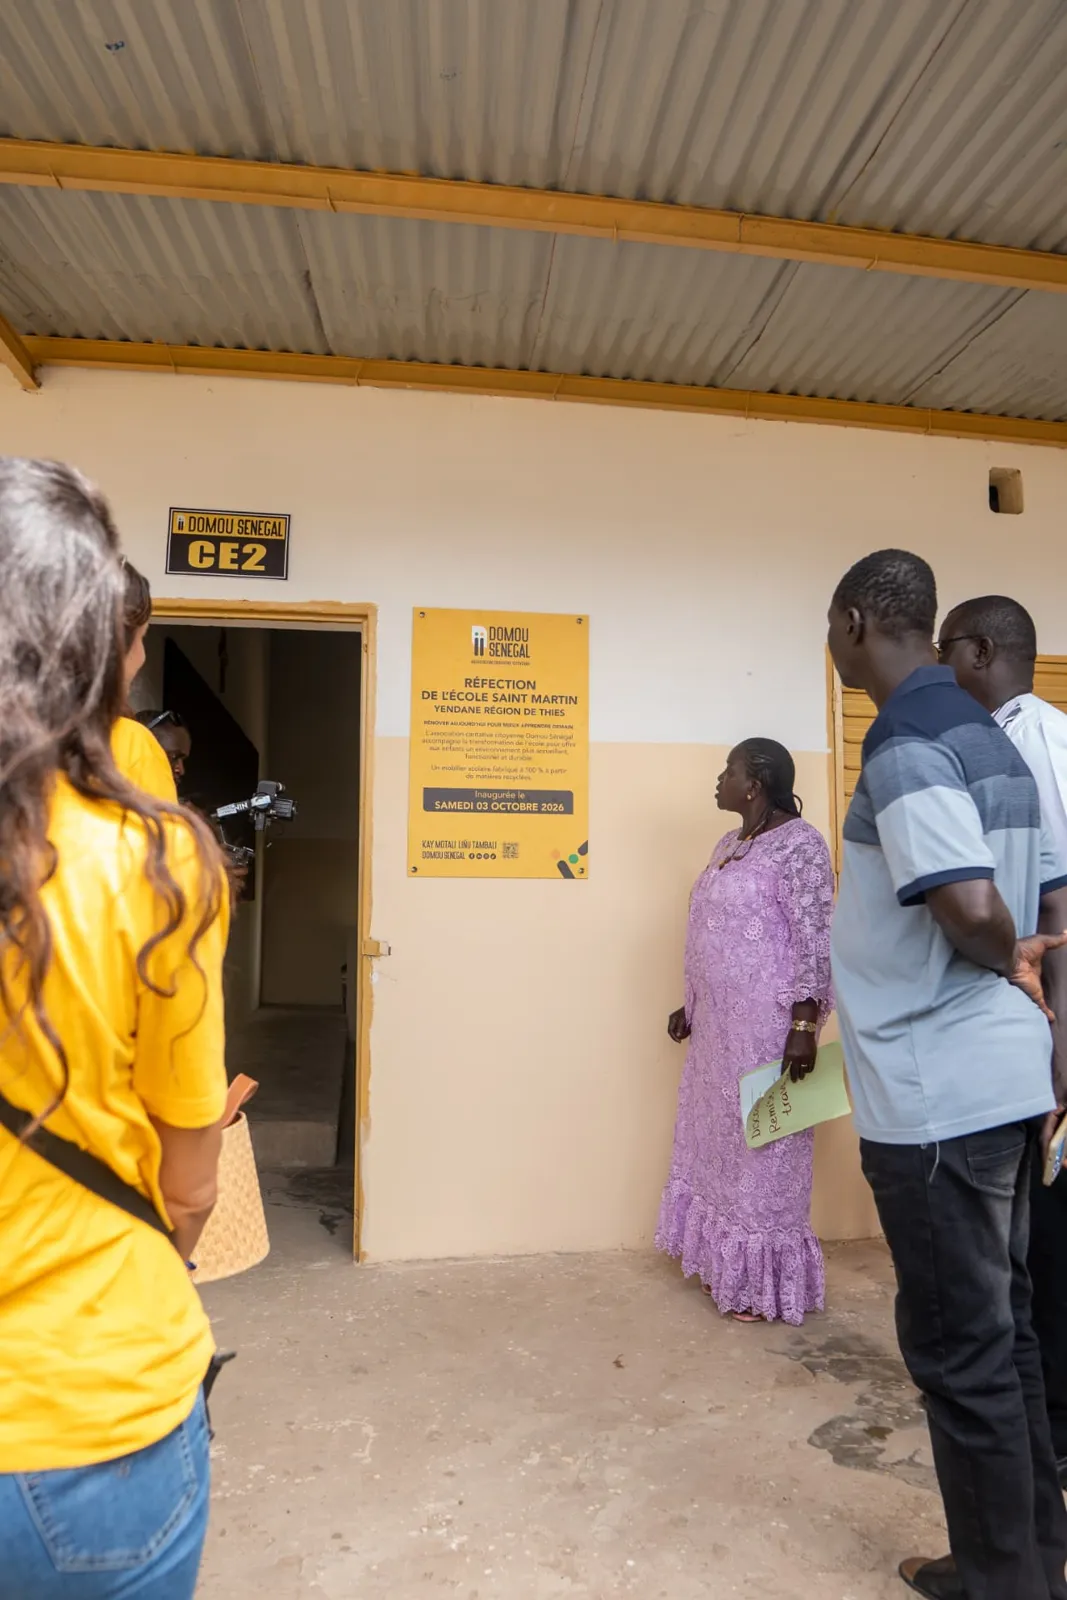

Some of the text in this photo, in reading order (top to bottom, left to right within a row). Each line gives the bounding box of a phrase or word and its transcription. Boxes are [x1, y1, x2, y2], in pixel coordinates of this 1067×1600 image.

[188, 516, 283, 537] DOMOU SENEGAL
[188, 540, 267, 571] CE2
[489, 626, 529, 642] DOMOU
[489, 642, 530, 658] SENEGAL
[464, 676, 536, 690] RÉFECTION
[421, 690, 438, 700] DE
[492, 692, 528, 704] SAINT
[531, 694, 578, 705] MARTIN
[434, 705, 565, 717] YENDANE RÉGION DE THIES
[475, 790, 525, 800] Inaugurée le
[434, 801, 565, 812] SAMEDI 03 OCTOBRE 2026
[422, 840, 435, 848] KAY
